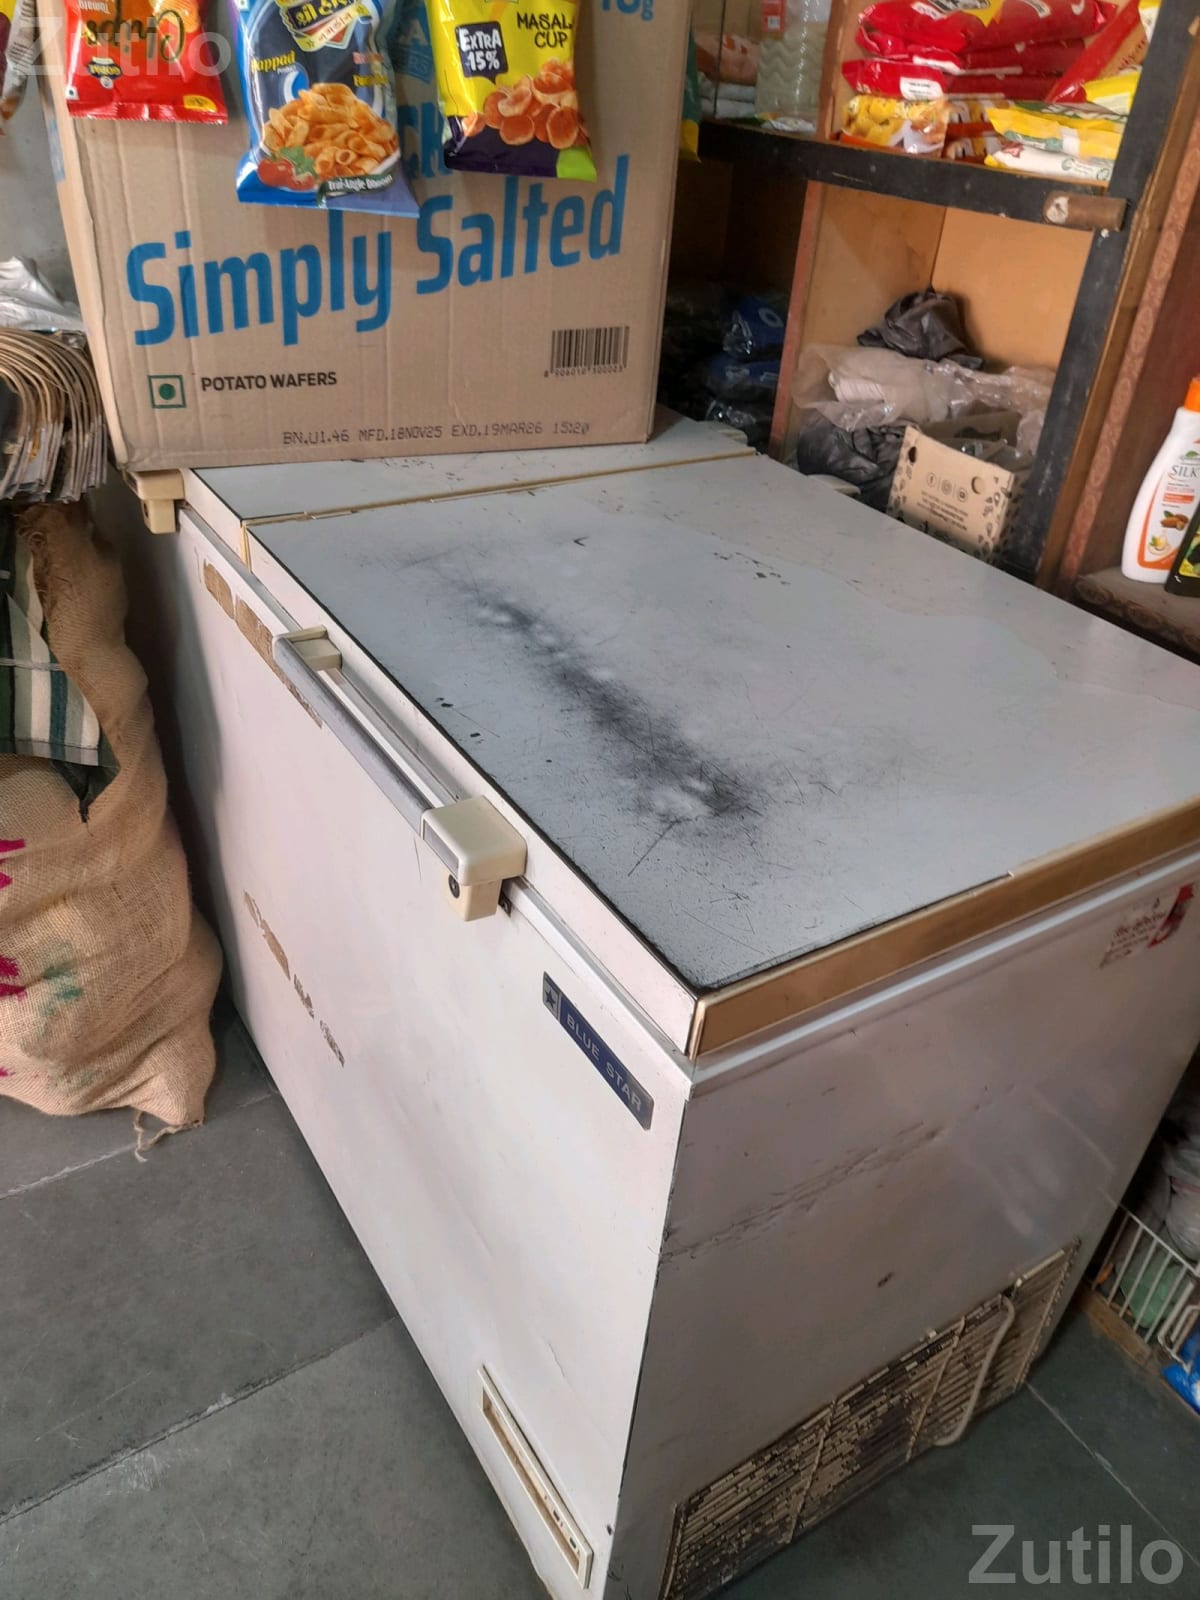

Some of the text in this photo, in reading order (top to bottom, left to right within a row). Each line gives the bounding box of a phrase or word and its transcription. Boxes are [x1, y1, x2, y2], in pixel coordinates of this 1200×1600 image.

[517, 12, 573, 30] MASAL
[534, 32, 567, 48] CUP
[467, 50, 500, 71] 15%
[126, 152, 630, 347] Simply Salted
[201, 372, 337, 391] POTATO WAFERS
[566, 1013, 642, 1111] BLUE STAR
